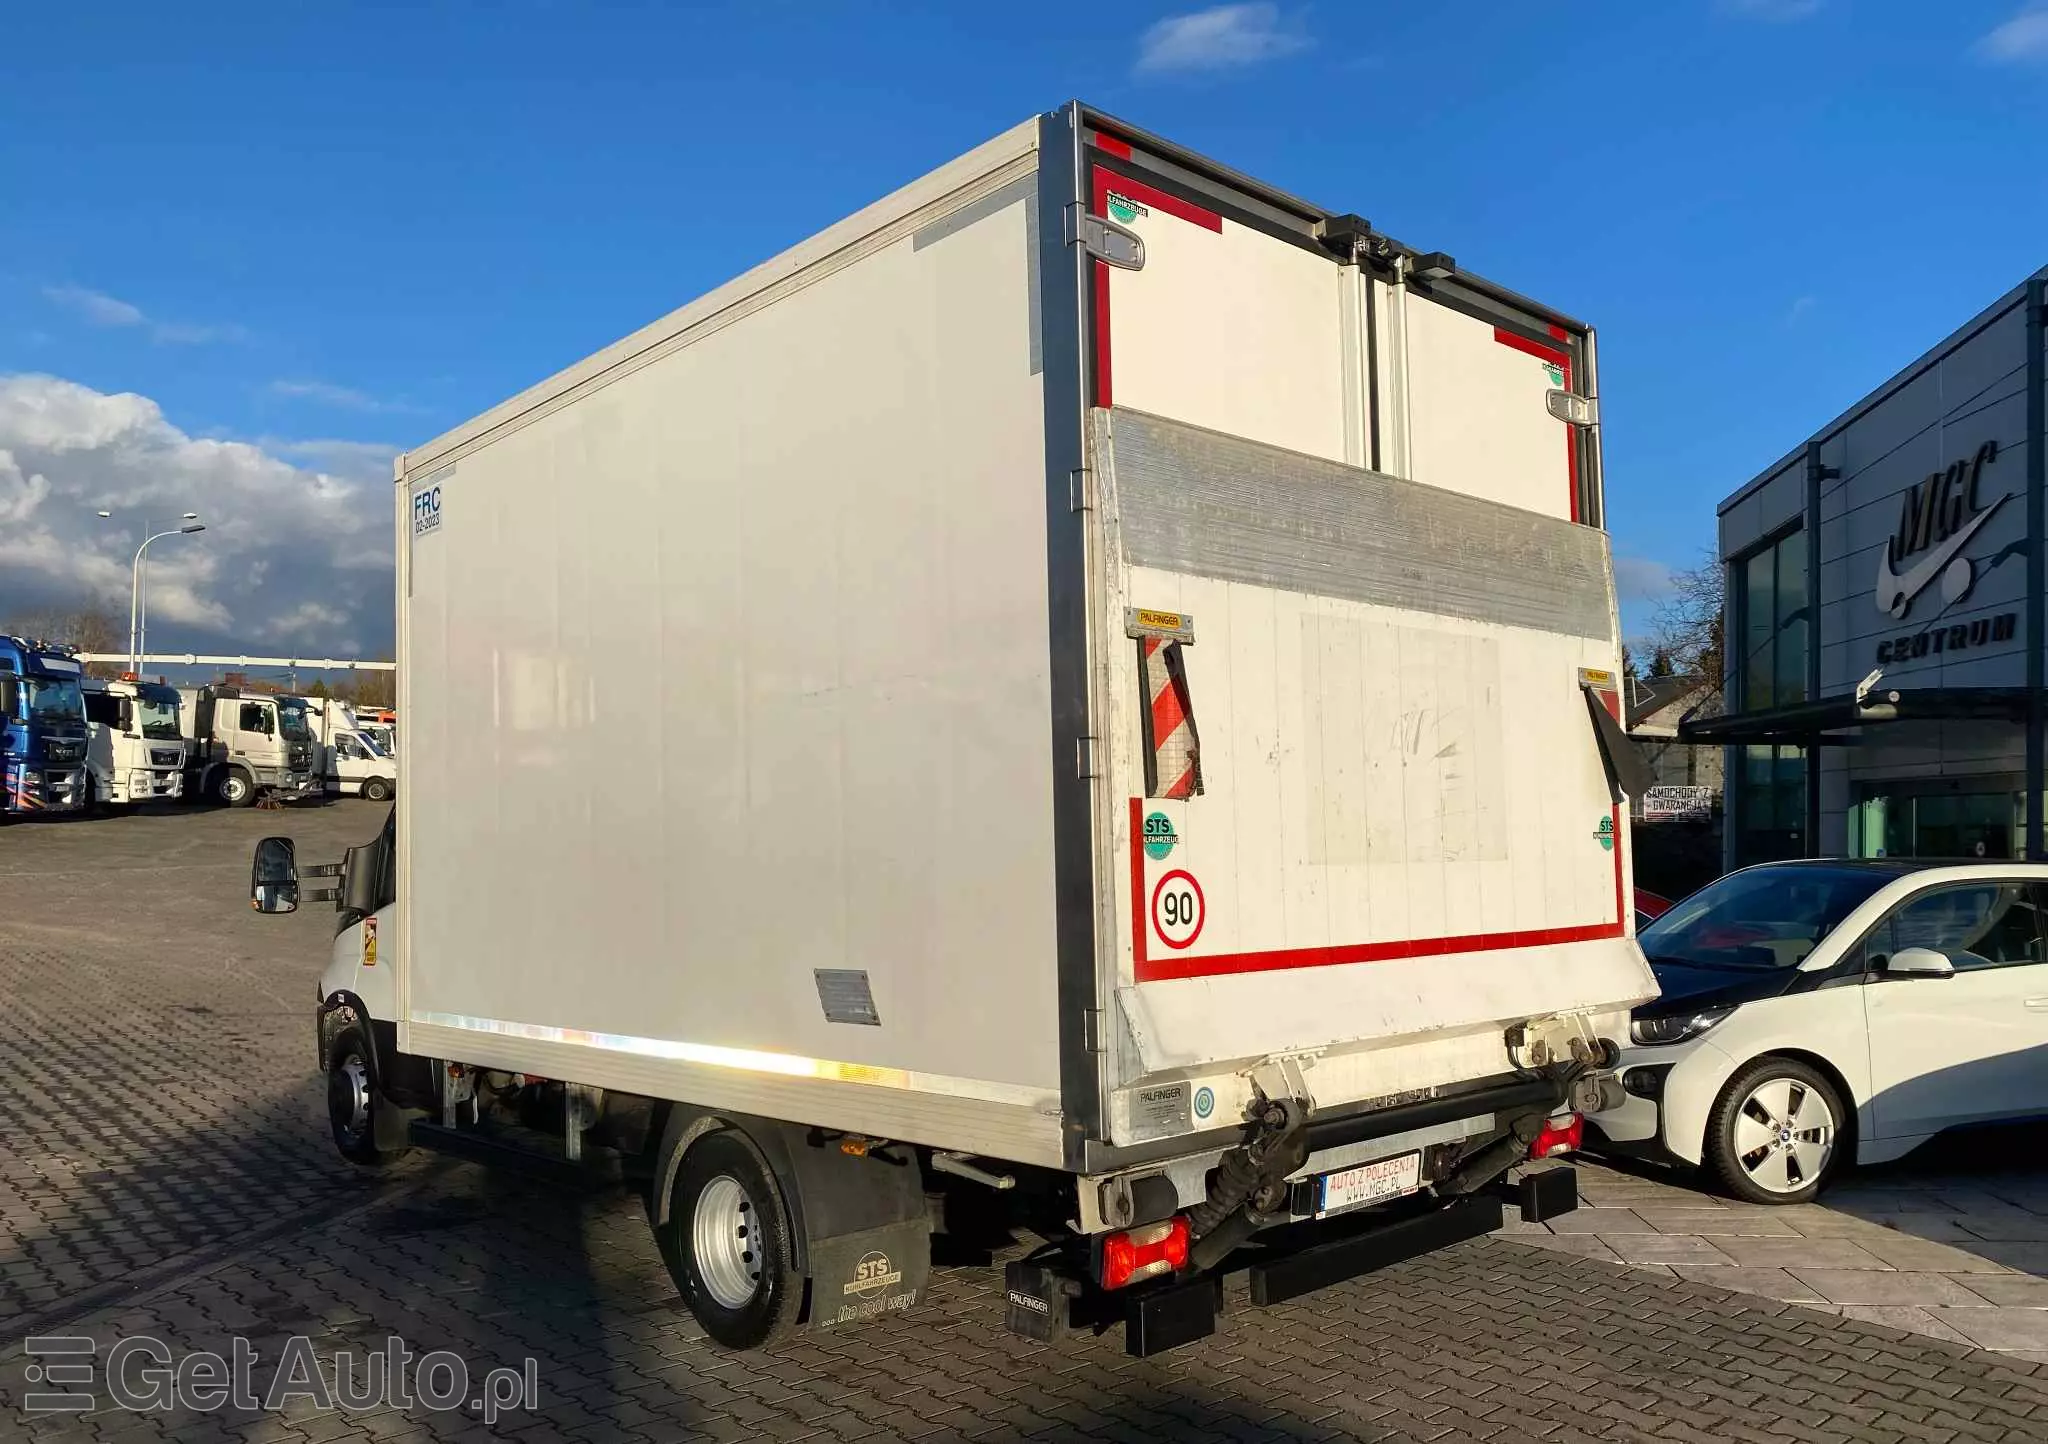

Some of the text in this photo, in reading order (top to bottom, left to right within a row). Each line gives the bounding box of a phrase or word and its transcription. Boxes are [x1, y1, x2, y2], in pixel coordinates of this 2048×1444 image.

[415, 486, 441, 520] FRC
[1894, 440, 1999, 562] MGC
[1140, 612, 1178, 625] PALFINGER
[1876, 613, 2016, 665] CENTRUM
[1646, 786, 1698, 799] SAMOCHODY
[1145, 818, 1170, 834] STS
[1600, 820, 1614, 832] STS
[1164, 891, 1193, 927] 90
[1140, 1087, 1181, 1104] PALFINGER
[1330, 1155, 1416, 1192] AUTO Z POLECENIA
[857, 1258, 888, 1280] STS
[838, 1304, 858, 1323] the
[861, 1294, 887, 1315] cool
[1009, 1292, 1048, 1313] PALFINGER
